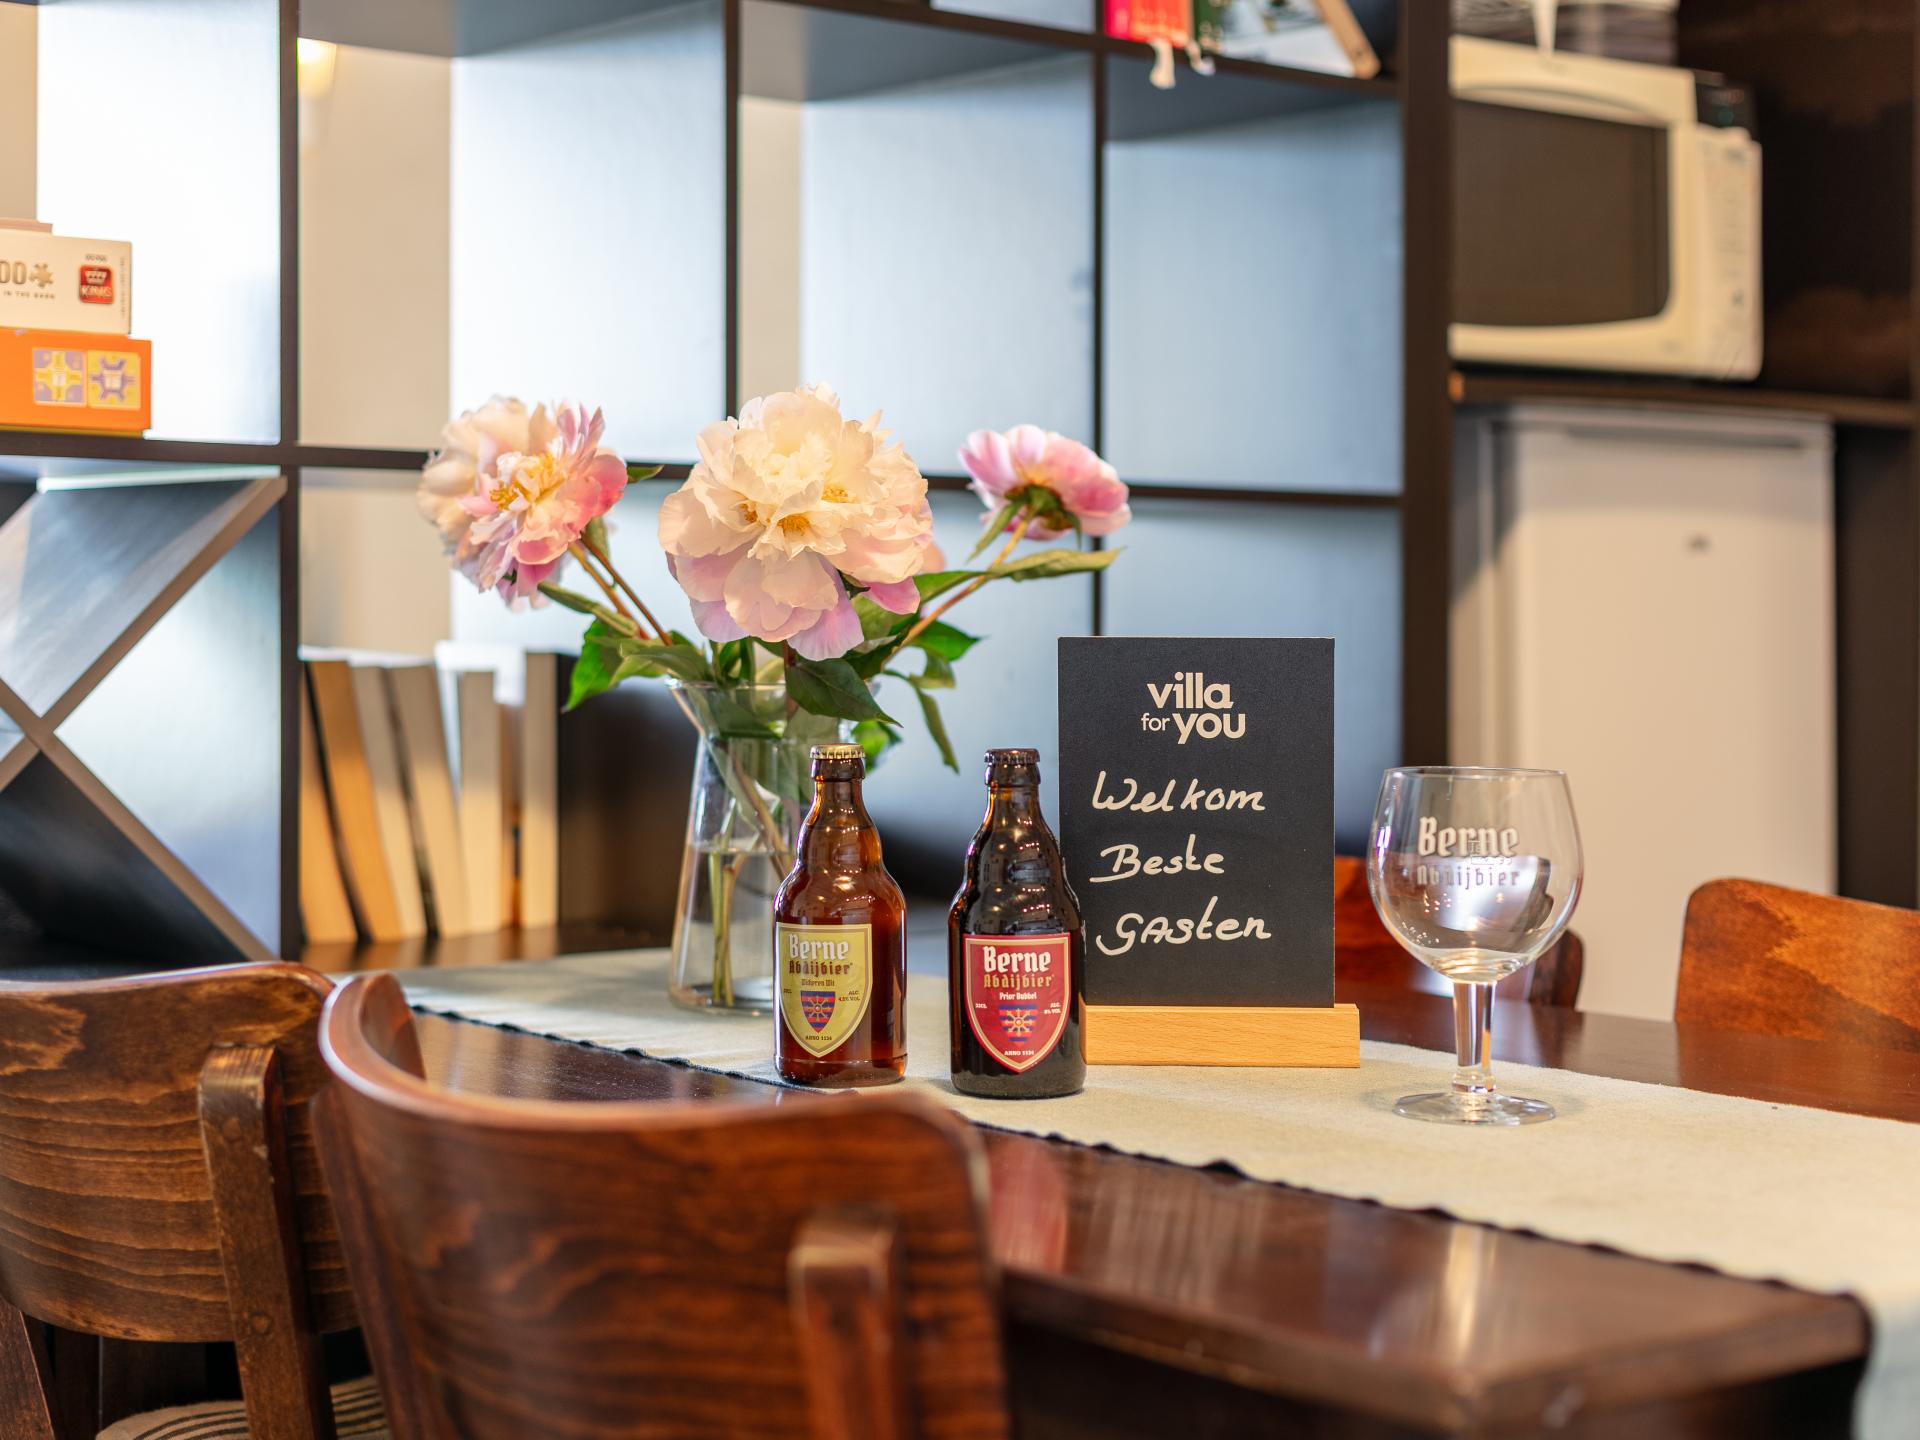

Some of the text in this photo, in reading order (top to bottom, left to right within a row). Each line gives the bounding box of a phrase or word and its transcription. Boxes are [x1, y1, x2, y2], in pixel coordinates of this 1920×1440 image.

[80, 284, 112, 299] KING
[1147, 671, 1234, 709] villa
[1141, 713, 1246, 744] for you
[1091, 771, 1265, 812] Welkom
[1418, 816, 1519, 858] Berne
[1089, 834, 1225, 882] Beste
[788, 933, 849, 960] Berne
[983, 945, 1051, 973] Berne
[789, 960, 851, 977] Abdijbier
[984, 974, 1052, 991] Abdijbier
[999, 991, 1015, 1000] Prior
